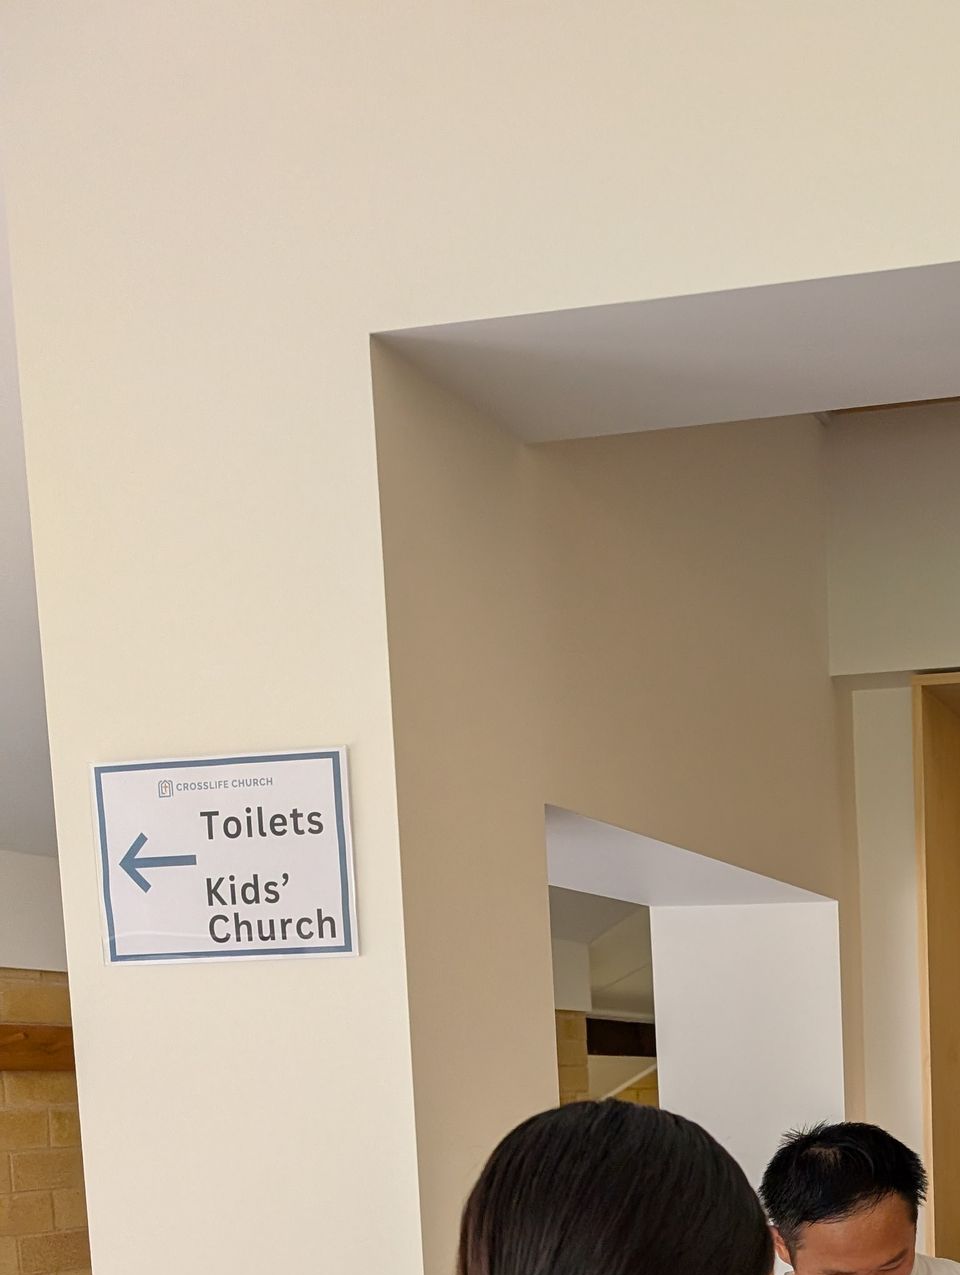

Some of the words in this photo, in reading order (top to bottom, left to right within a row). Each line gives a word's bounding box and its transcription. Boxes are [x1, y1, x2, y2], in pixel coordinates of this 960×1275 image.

[176, 779, 229, 792] CROSSLIFE
[231, 777, 273, 788] CHURCH
[200, 806, 324, 840] Toilets
[206, 873, 289, 906] Kids'
[208, 908, 337, 943] Church
